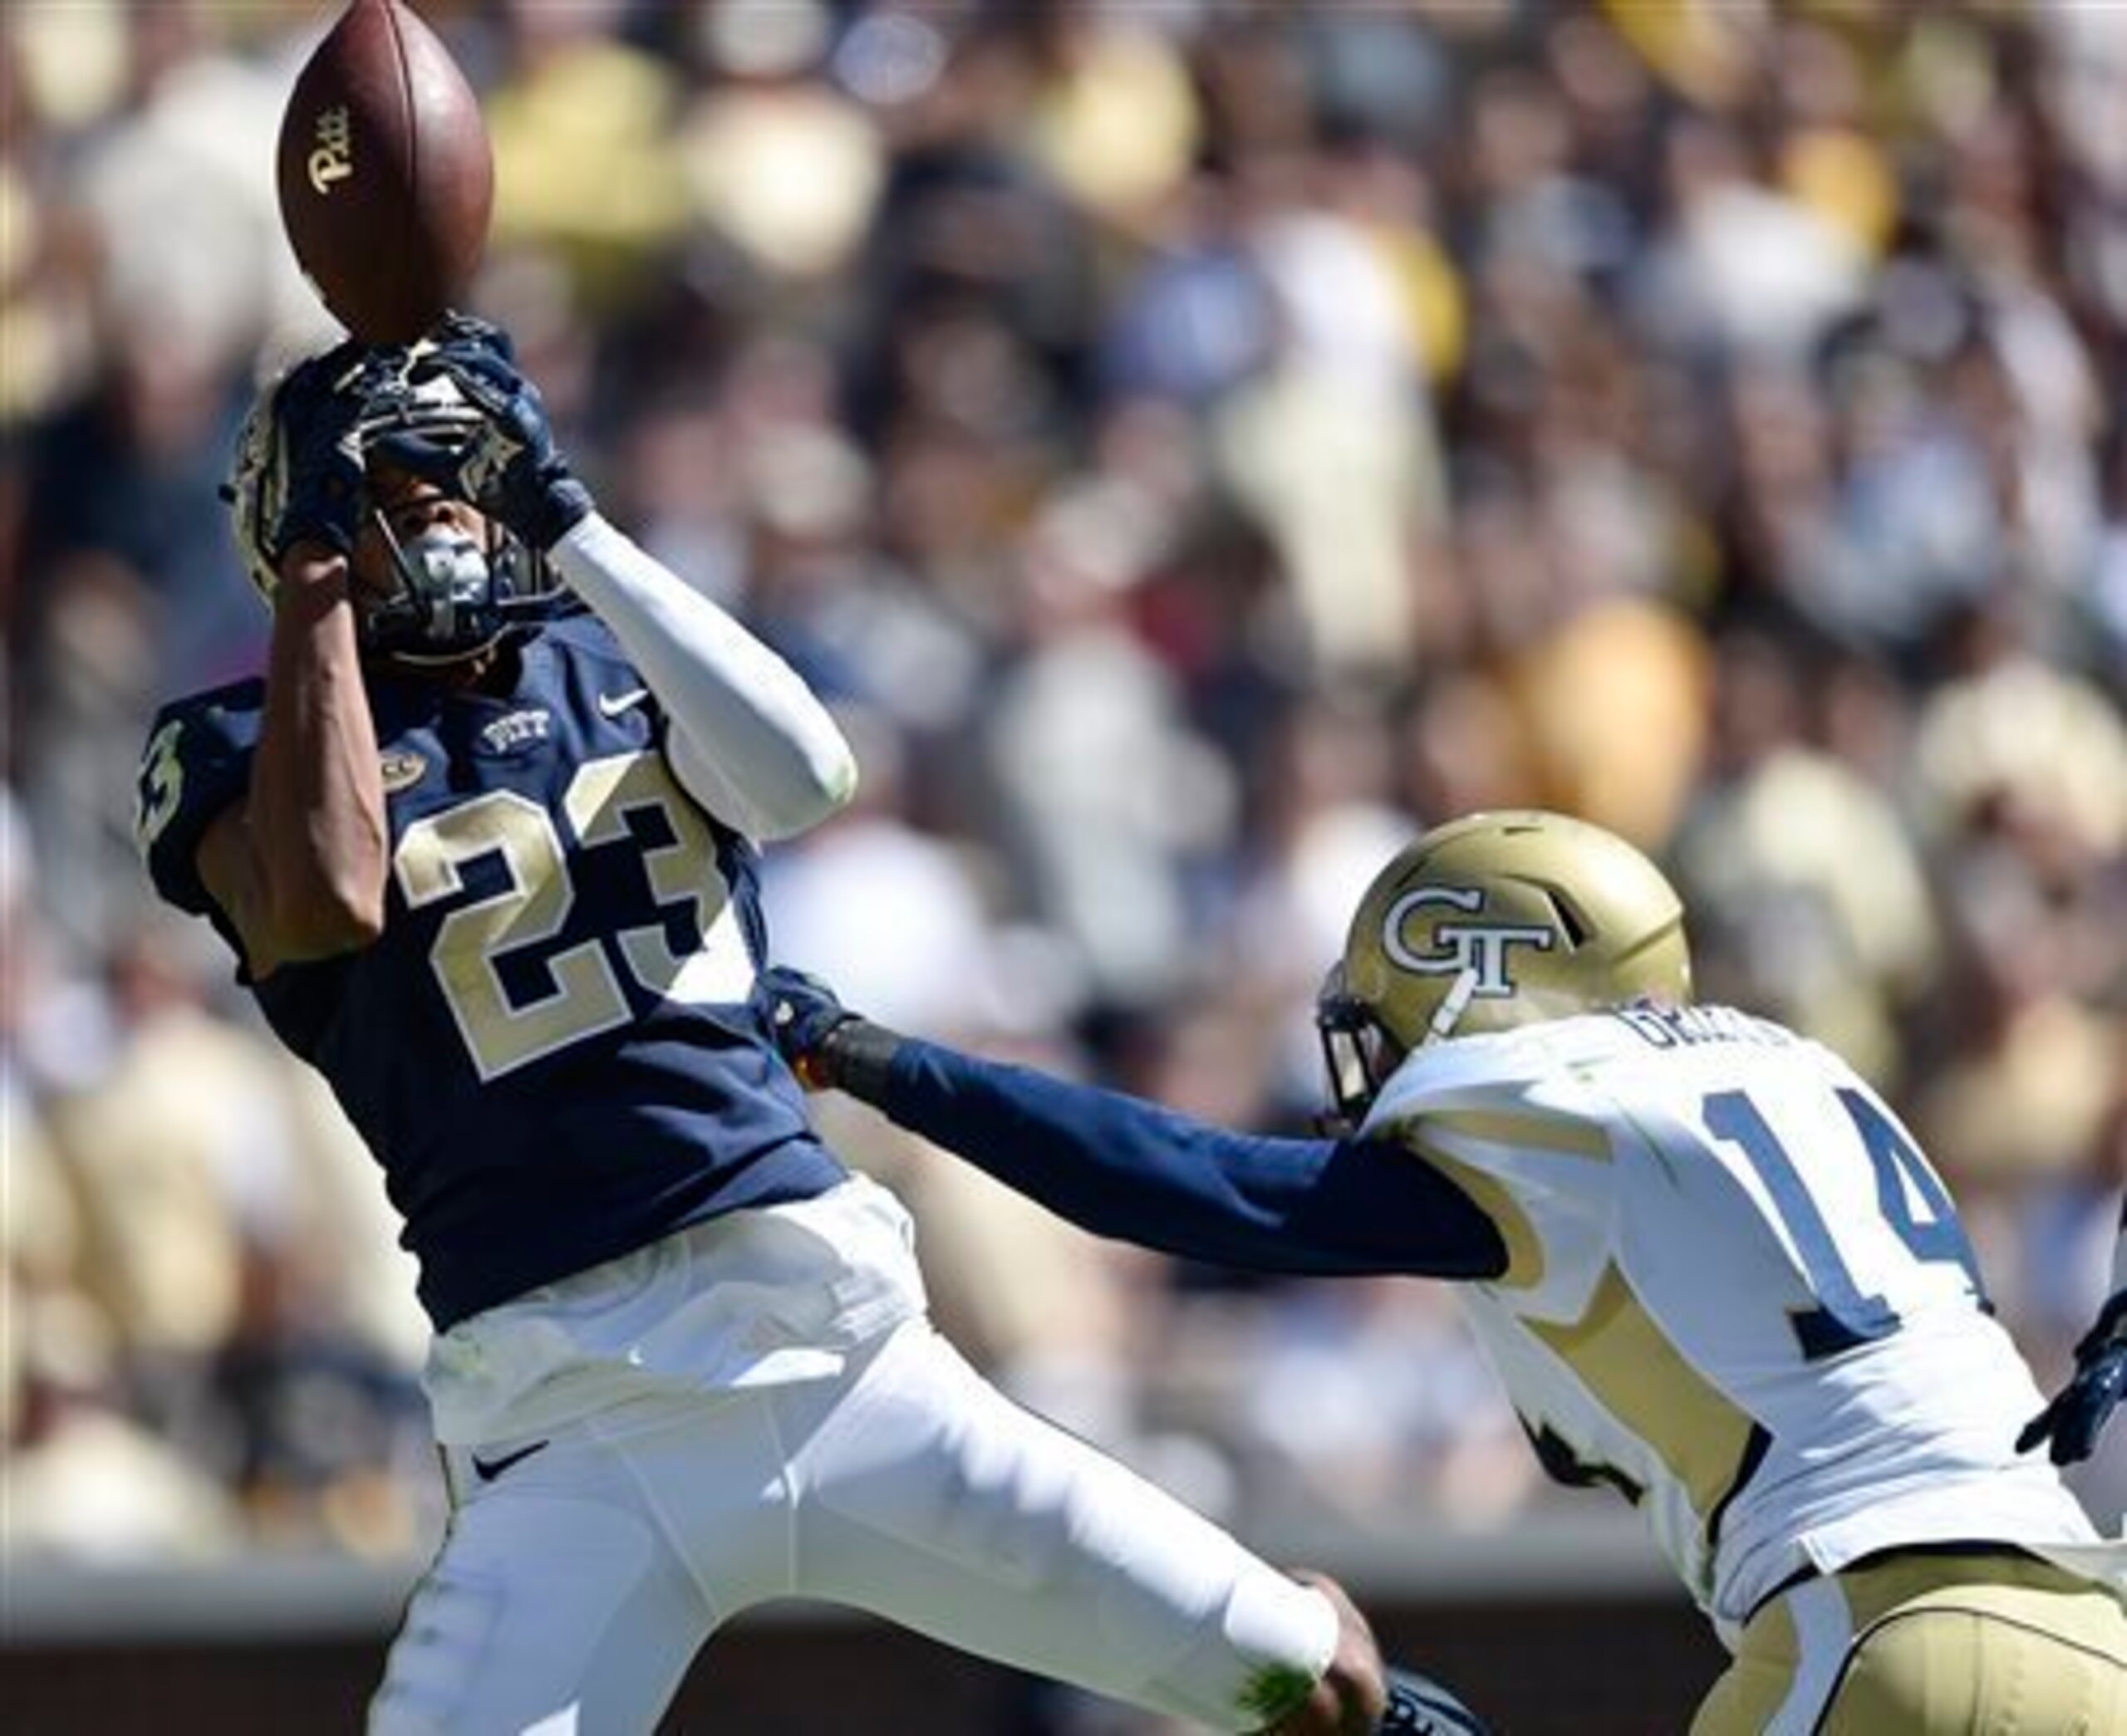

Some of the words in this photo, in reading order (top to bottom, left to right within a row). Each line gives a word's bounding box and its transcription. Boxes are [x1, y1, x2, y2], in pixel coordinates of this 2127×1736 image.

[483, 709, 550, 753] PITT
[395, 750, 754, 1083] 23
[1383, 886, 1552, 998] GT
[1702, 1089, 1996, 1362] 14
